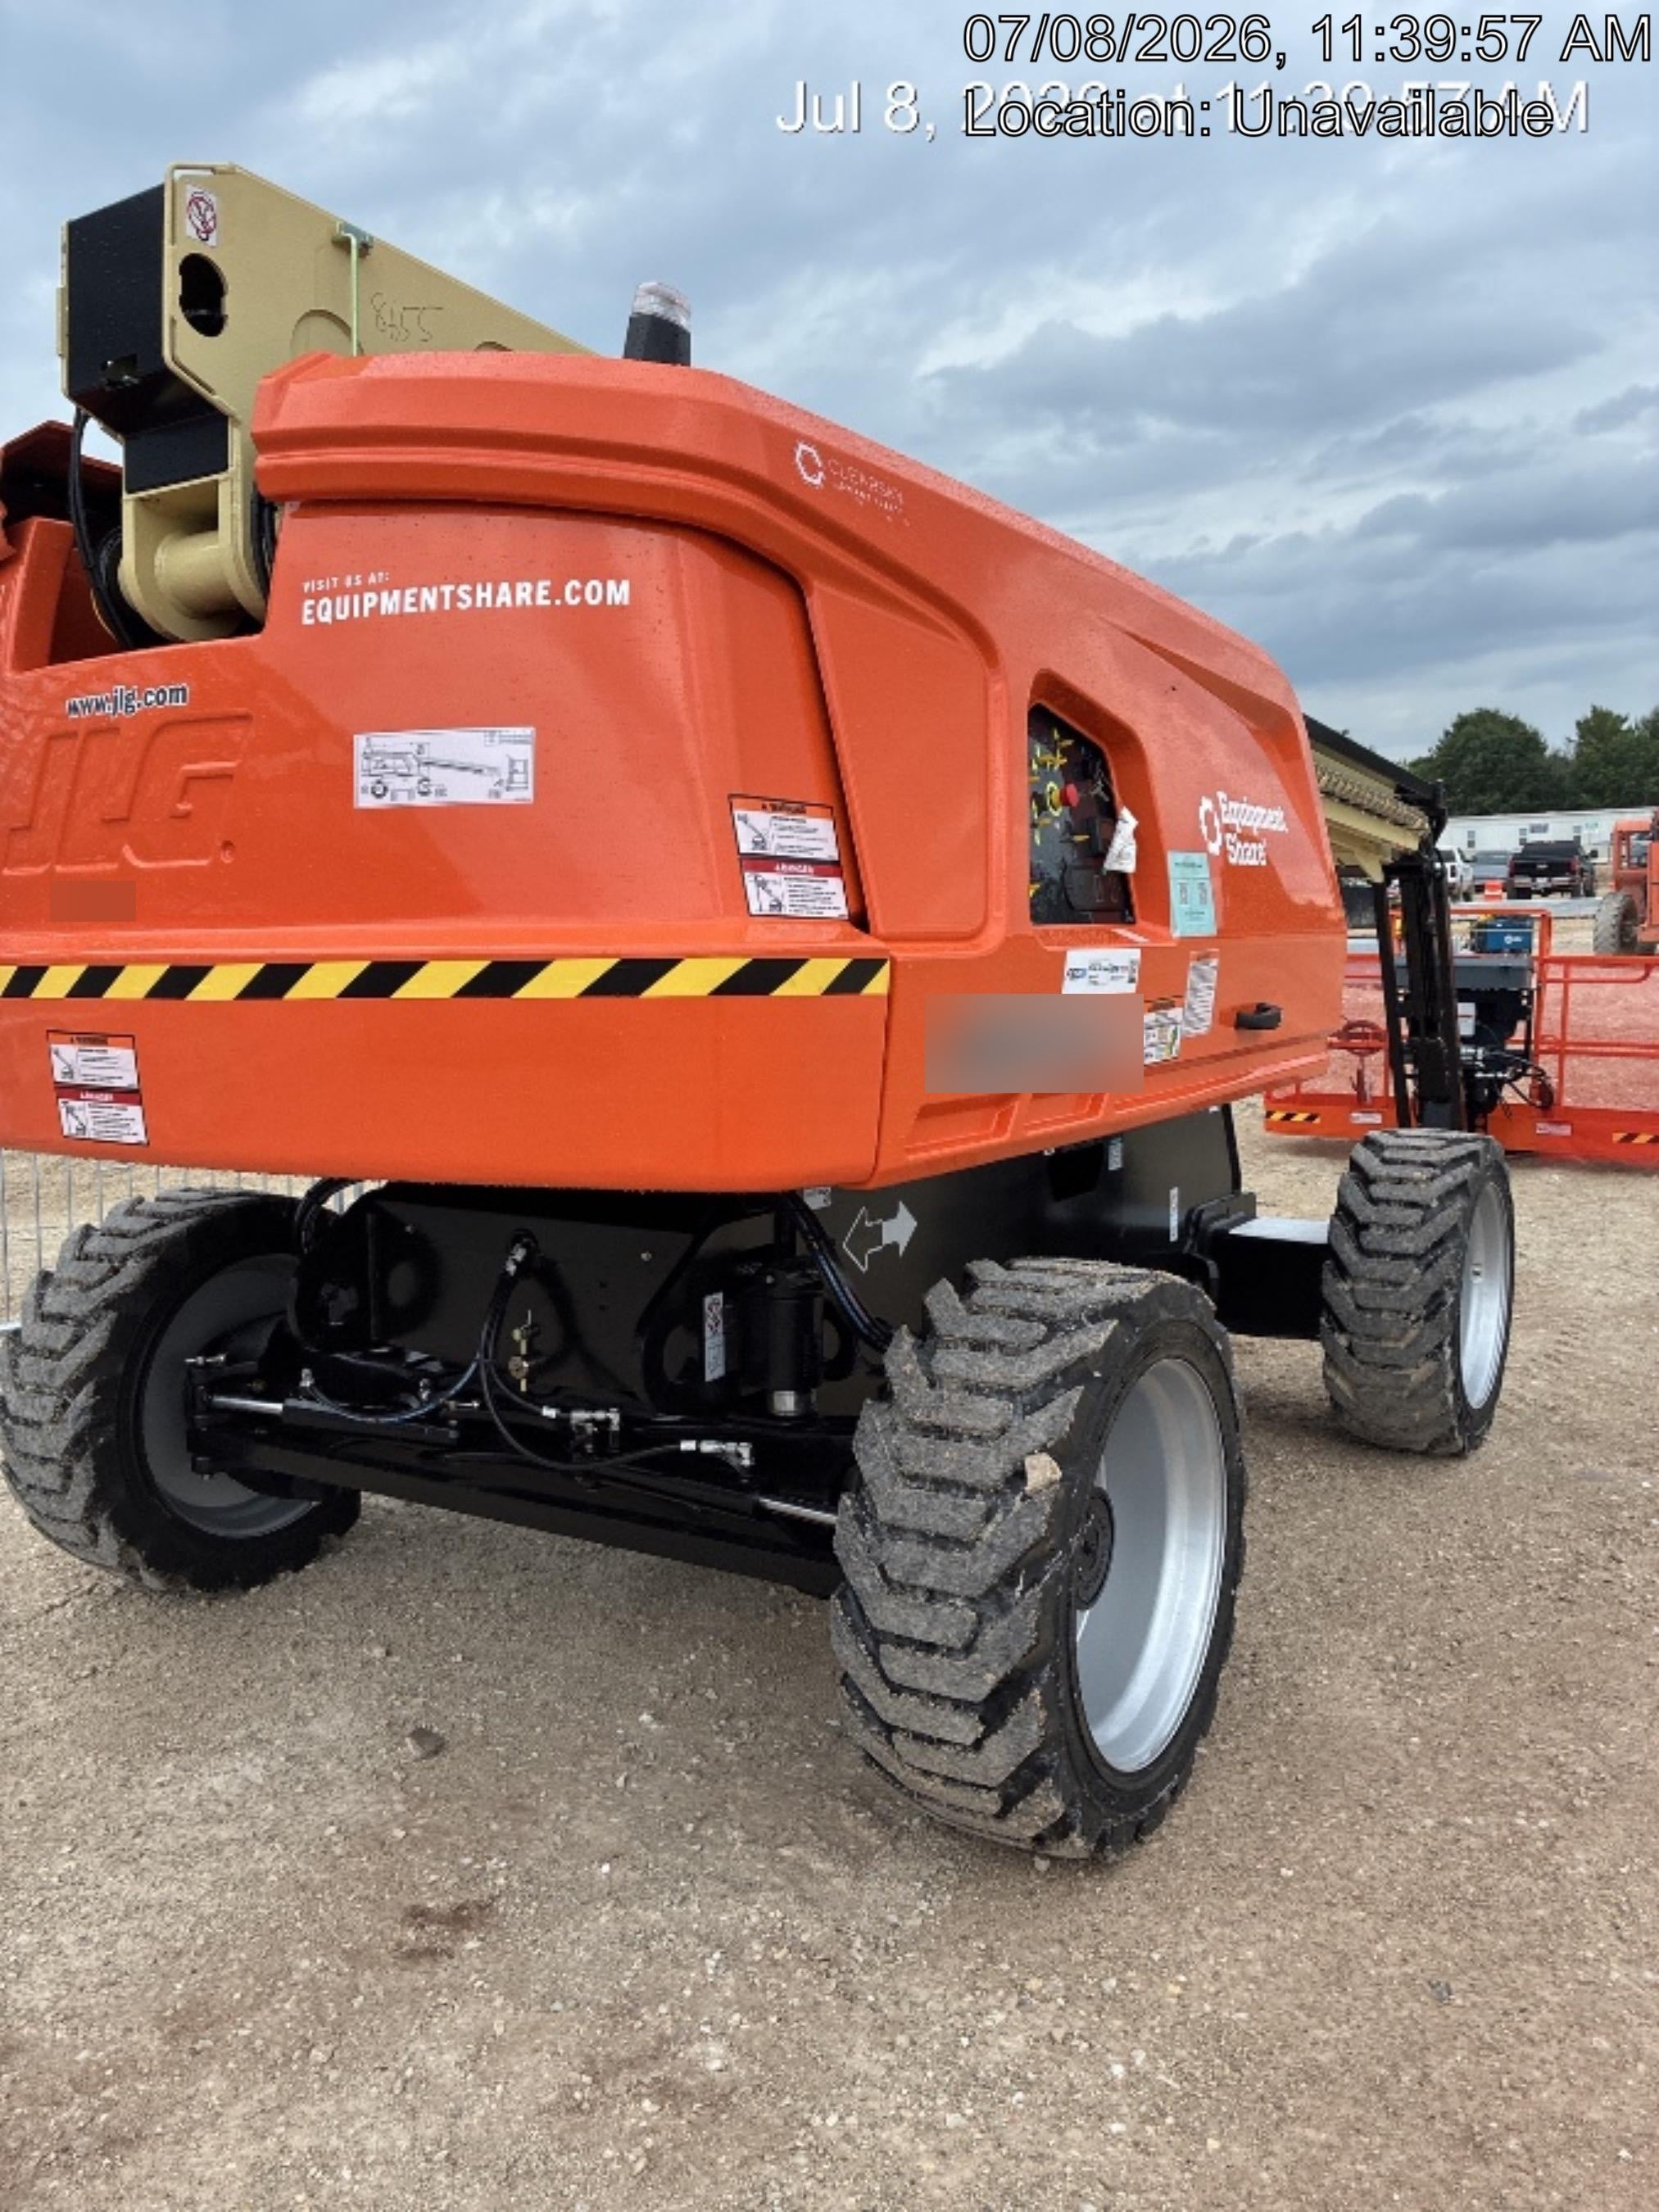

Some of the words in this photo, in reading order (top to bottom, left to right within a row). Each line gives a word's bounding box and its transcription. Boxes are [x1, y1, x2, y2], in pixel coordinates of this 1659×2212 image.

[301, 576, 339, 593] VISIT
[301, 579, 630, 625] EQUIPMENTSHARE.COM
[66, 684, 189, 717] www.jlg.com
